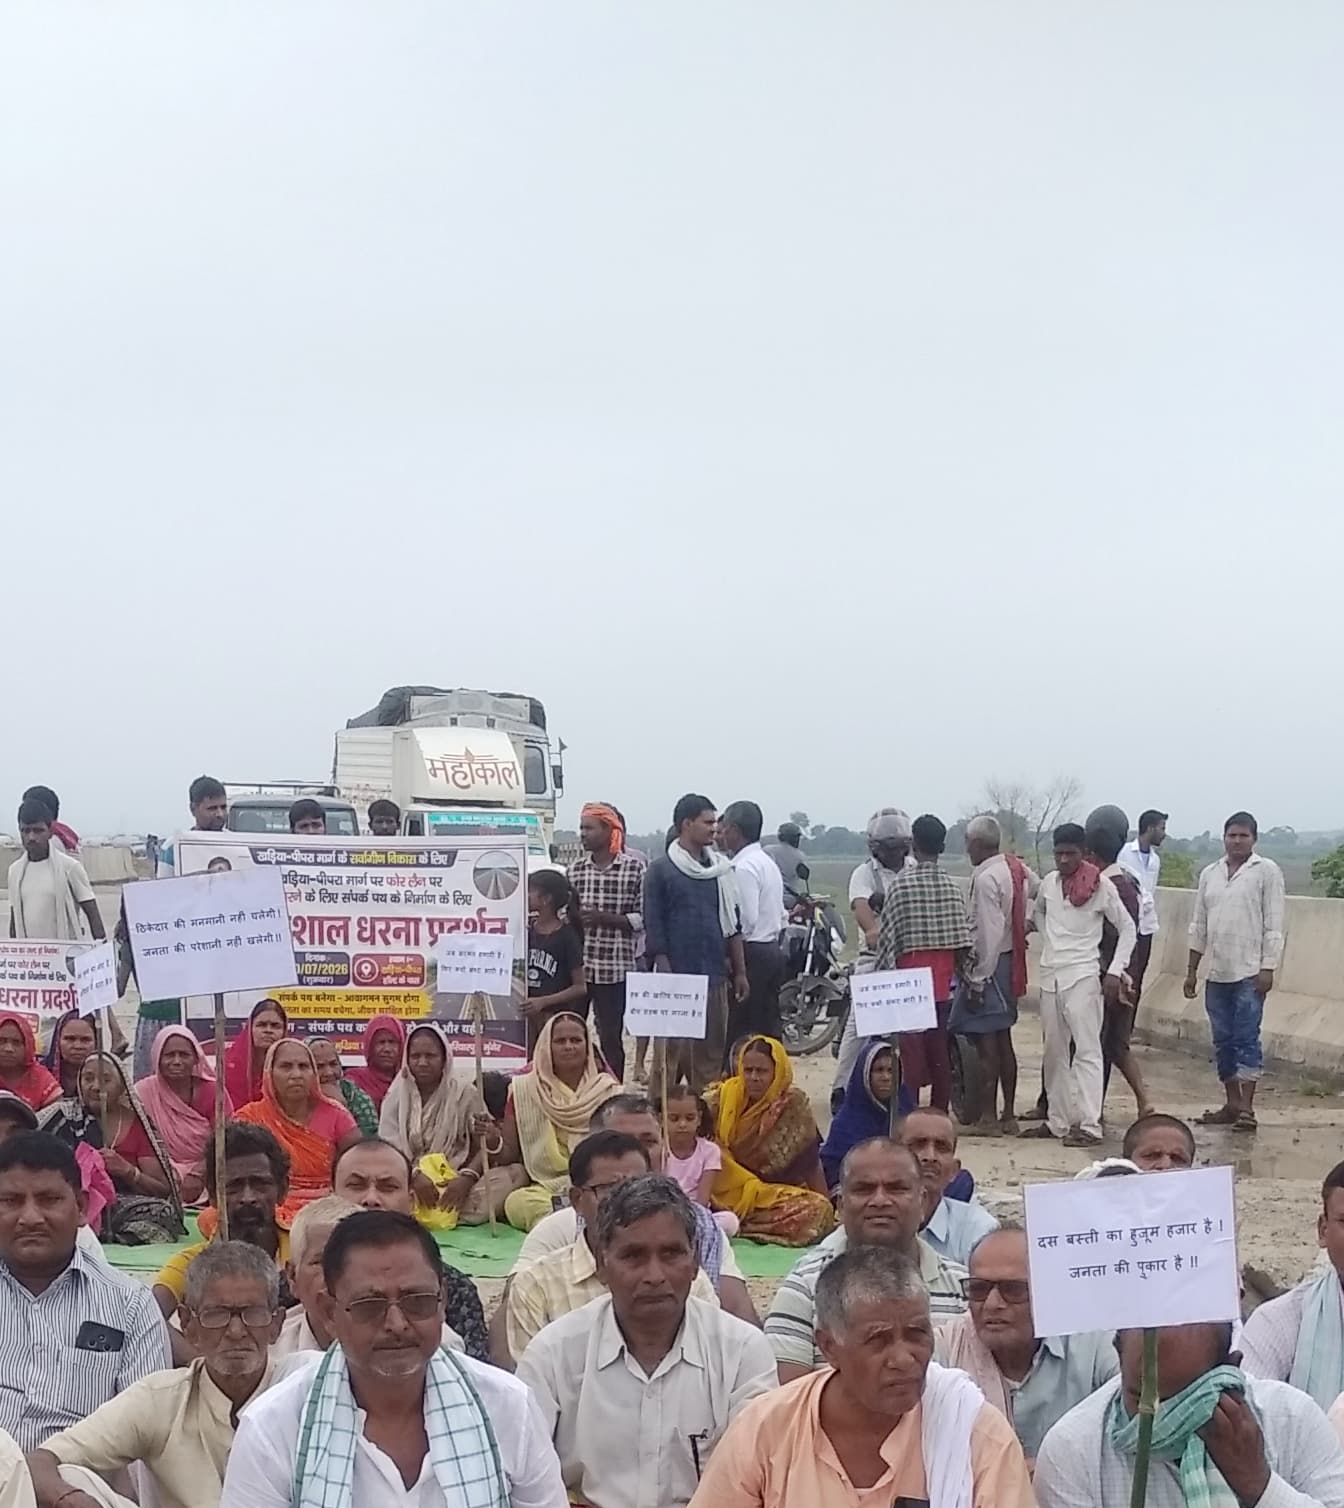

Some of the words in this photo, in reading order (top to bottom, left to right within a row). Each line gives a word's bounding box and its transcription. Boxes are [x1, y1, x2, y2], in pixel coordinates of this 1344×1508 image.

[425, 758, 520, 789] महाकाल
[431, 851, 448, 865] लिए
[346, 872, 367, 886] मार्ग
[370, 877, 383, 887] पर
[386, 873, 406, 887] फोर
[429, 877, 442, 887] पर
[305, 889, 316, 903] के
[319, 889, 338, 904] लिए
[342, 888, 368, 903] संपर्क
[390, 890, 401, 903] के
[404, 888, 435, 905] निर्माण
[439, 891, 449, 904] के
[453, 890, 472, 906] लिए
[136, 922, 168, 933] ठिकेदार
[174, 919, 185, 928] की
[191, 914, 225, 926] मनमानी
[357, 915, 421, 946] धरना
[143, 946, 169, 957] जनता
[174, 943, 185, 952] की
[191, 938, 221, 951] परेशानी
[41, 983, 78, 1010] प्रदर्श
[284, 1006, 299, 1014] नता
[308, 1022, 334, 1032] संपर्क
[337, 1023, 352, 1032] पथ
[1038, 1235, 1057, 1249] दस
[1066, 1229, 1099, 1245] बस्ती
[1107, 1229, 1123, 1242] का
[1130, 1226, 1160, 1247] हुजूम
[1167, 1222, 1197, 1238] हजार
[1204, 1217, 1213, 1234] है
[1069, 1264, 1107, 1279] जनता
[1114, 1260, 1130, 1274] की
[1137, 1259, 1168, 1279] पुकार
[1174, 1254, 1183, 1271] है
